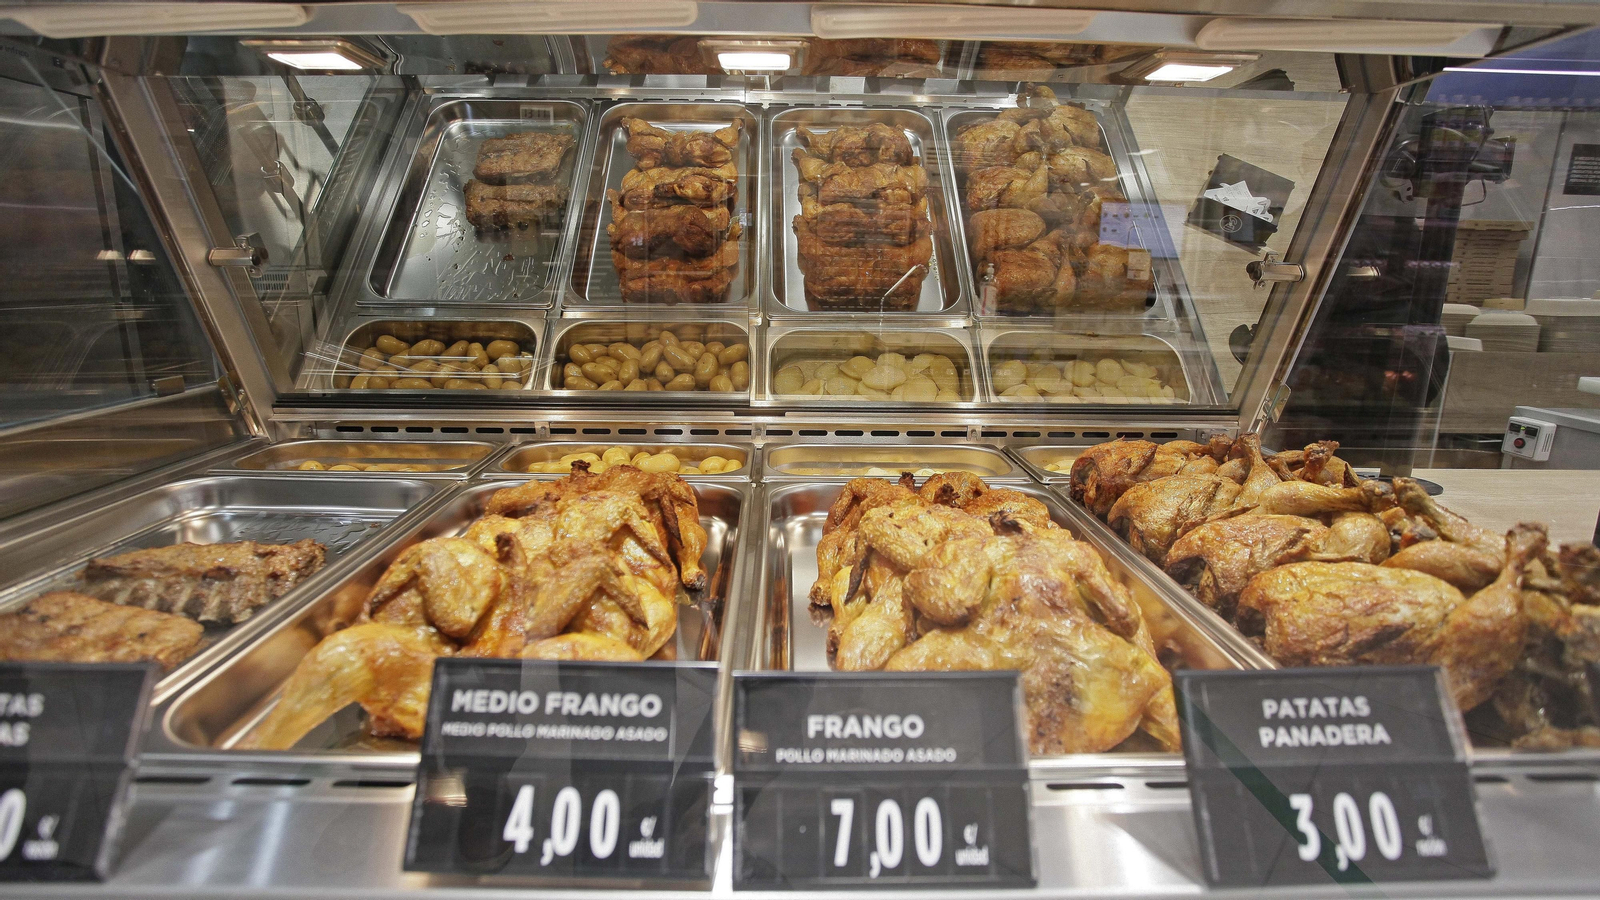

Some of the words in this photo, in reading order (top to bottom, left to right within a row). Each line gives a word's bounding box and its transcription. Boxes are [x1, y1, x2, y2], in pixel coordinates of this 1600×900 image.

[451, 689, 540, 714] MEDIO
[544, 691, 663, 718] FRANGO
[1261, 695, 1371, 720] PATATAS
[441, 722, 486, 738] MEDIO
[486, 722, 536, 739] POLLO
[536, 724, 615, 741] MARINADO
[614, 726, 668, 743] ASADO
[807, 713, 925, 739] FRANGO
[1258, 721, 1392, 748] PANADERA
[775, 747, 825, 763] POLLO
[826, 747, 904, 763] MARINADO
[905, 747, 957, 763] ASADO
[502, 784, 621, 867] 4,00
[830, 796, 943, 879] 7,00
[1288, 790, 1403, 872] 3,00
